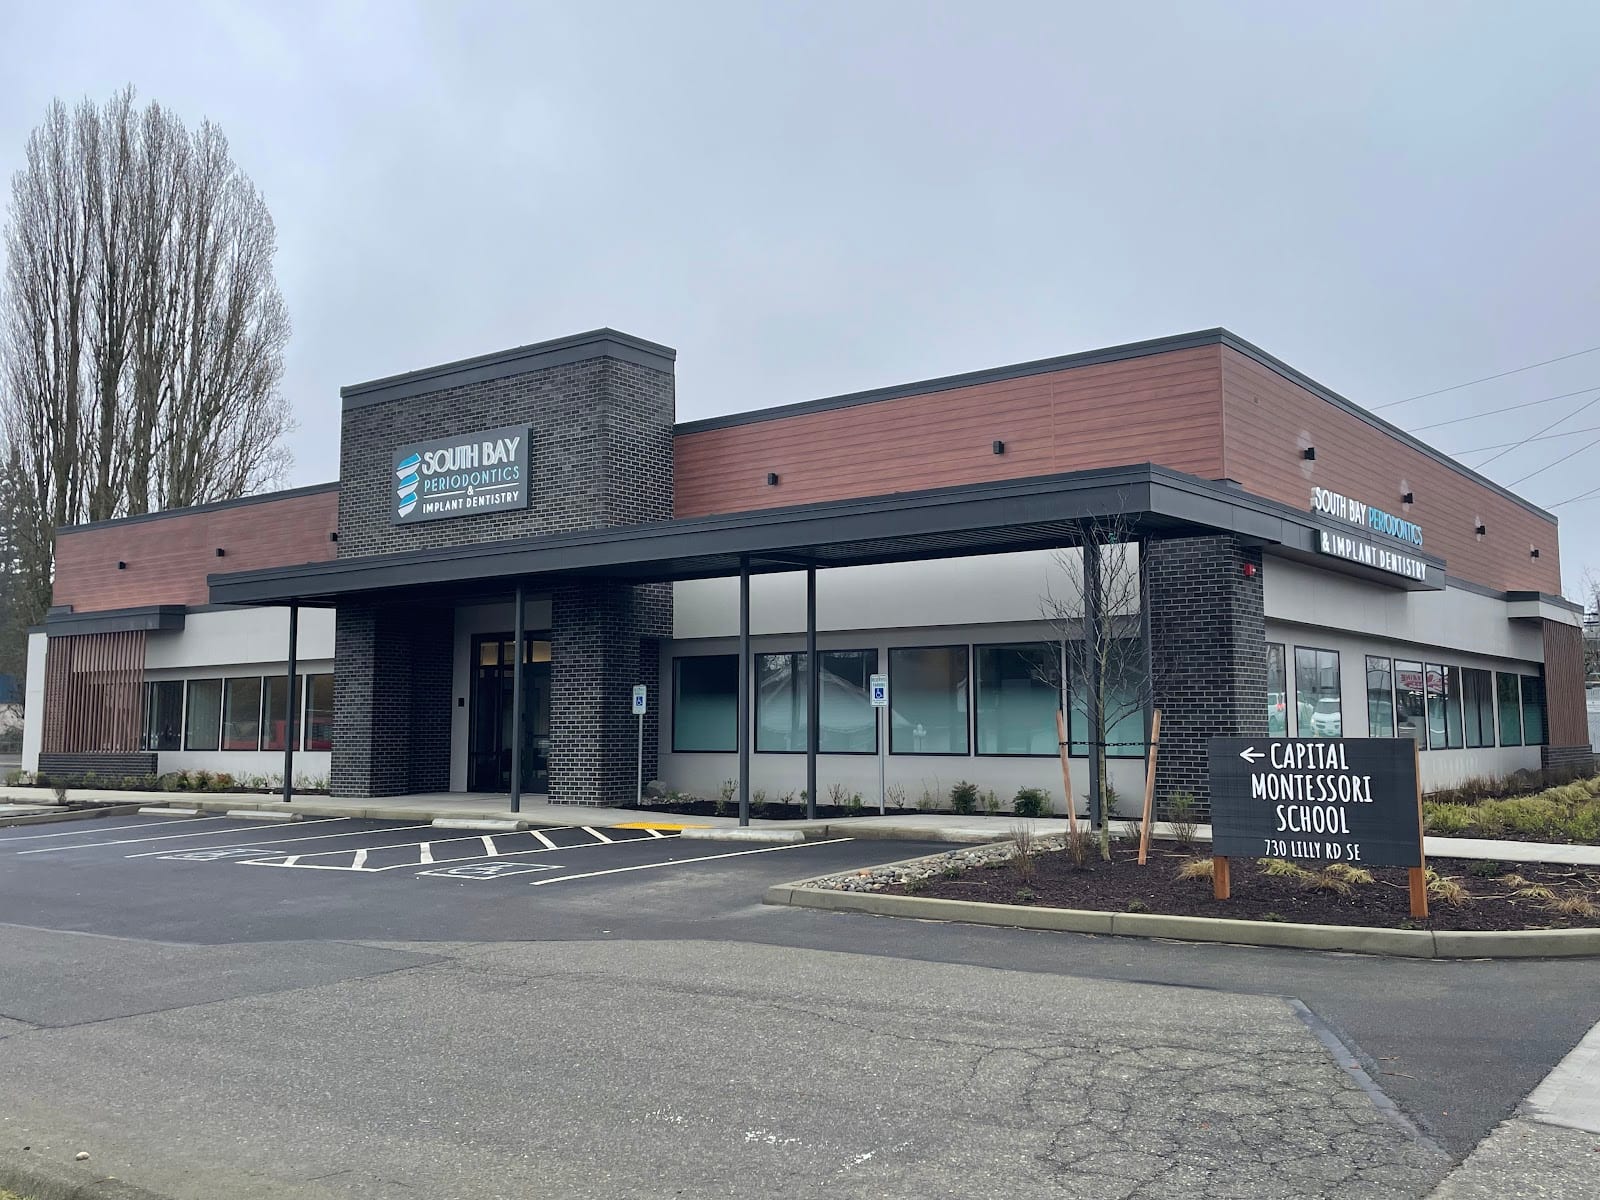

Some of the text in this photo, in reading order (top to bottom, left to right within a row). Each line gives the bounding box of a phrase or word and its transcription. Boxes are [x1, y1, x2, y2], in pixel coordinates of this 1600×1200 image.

[422, 437, 520, 475] SOUTH BAY
[424, 465, 520, 493] PERIODONTICS
[467, 485, 474, 496] &
[422, 491, 519, 514] IMPLANT DENTISTRY
[1312, 486, 1423, 546] SOUTH BAY PERIODONTICS
[1322, 531, 1426, 580] & IMPLANT DENTISTRY
[1270, 742, 1349, 770] CAPITAL
[1251, 773, 1373, 803] MONTESSORI
[1276, 804, 1350, 834] SCHOOL
[1264, 839, 1361, 861] 730 LILLY RD SE
